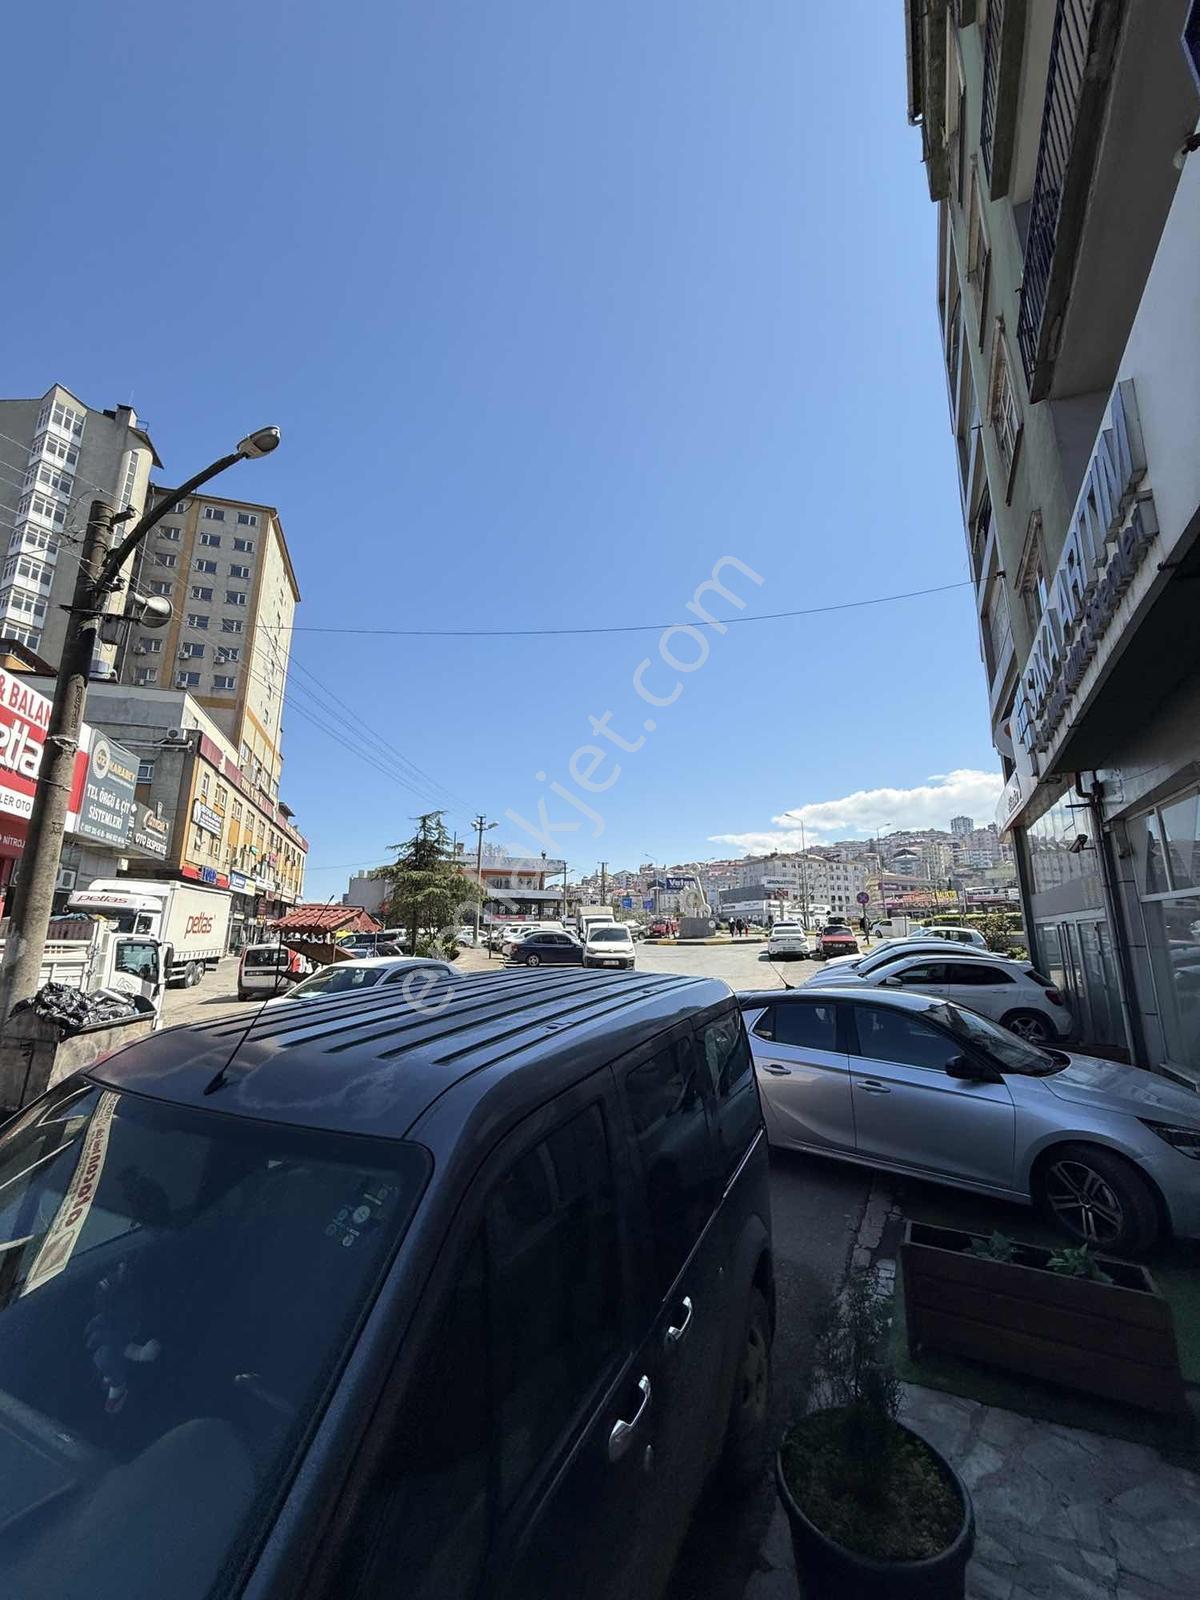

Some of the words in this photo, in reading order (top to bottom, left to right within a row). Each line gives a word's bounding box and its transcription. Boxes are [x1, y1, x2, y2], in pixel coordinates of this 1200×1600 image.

[87, 783, 98, 800] TEL
[16, 798, 31, 812] OTO
[77, 894, 128, 904] petlas
[184, 911, 213, 939] petlas
